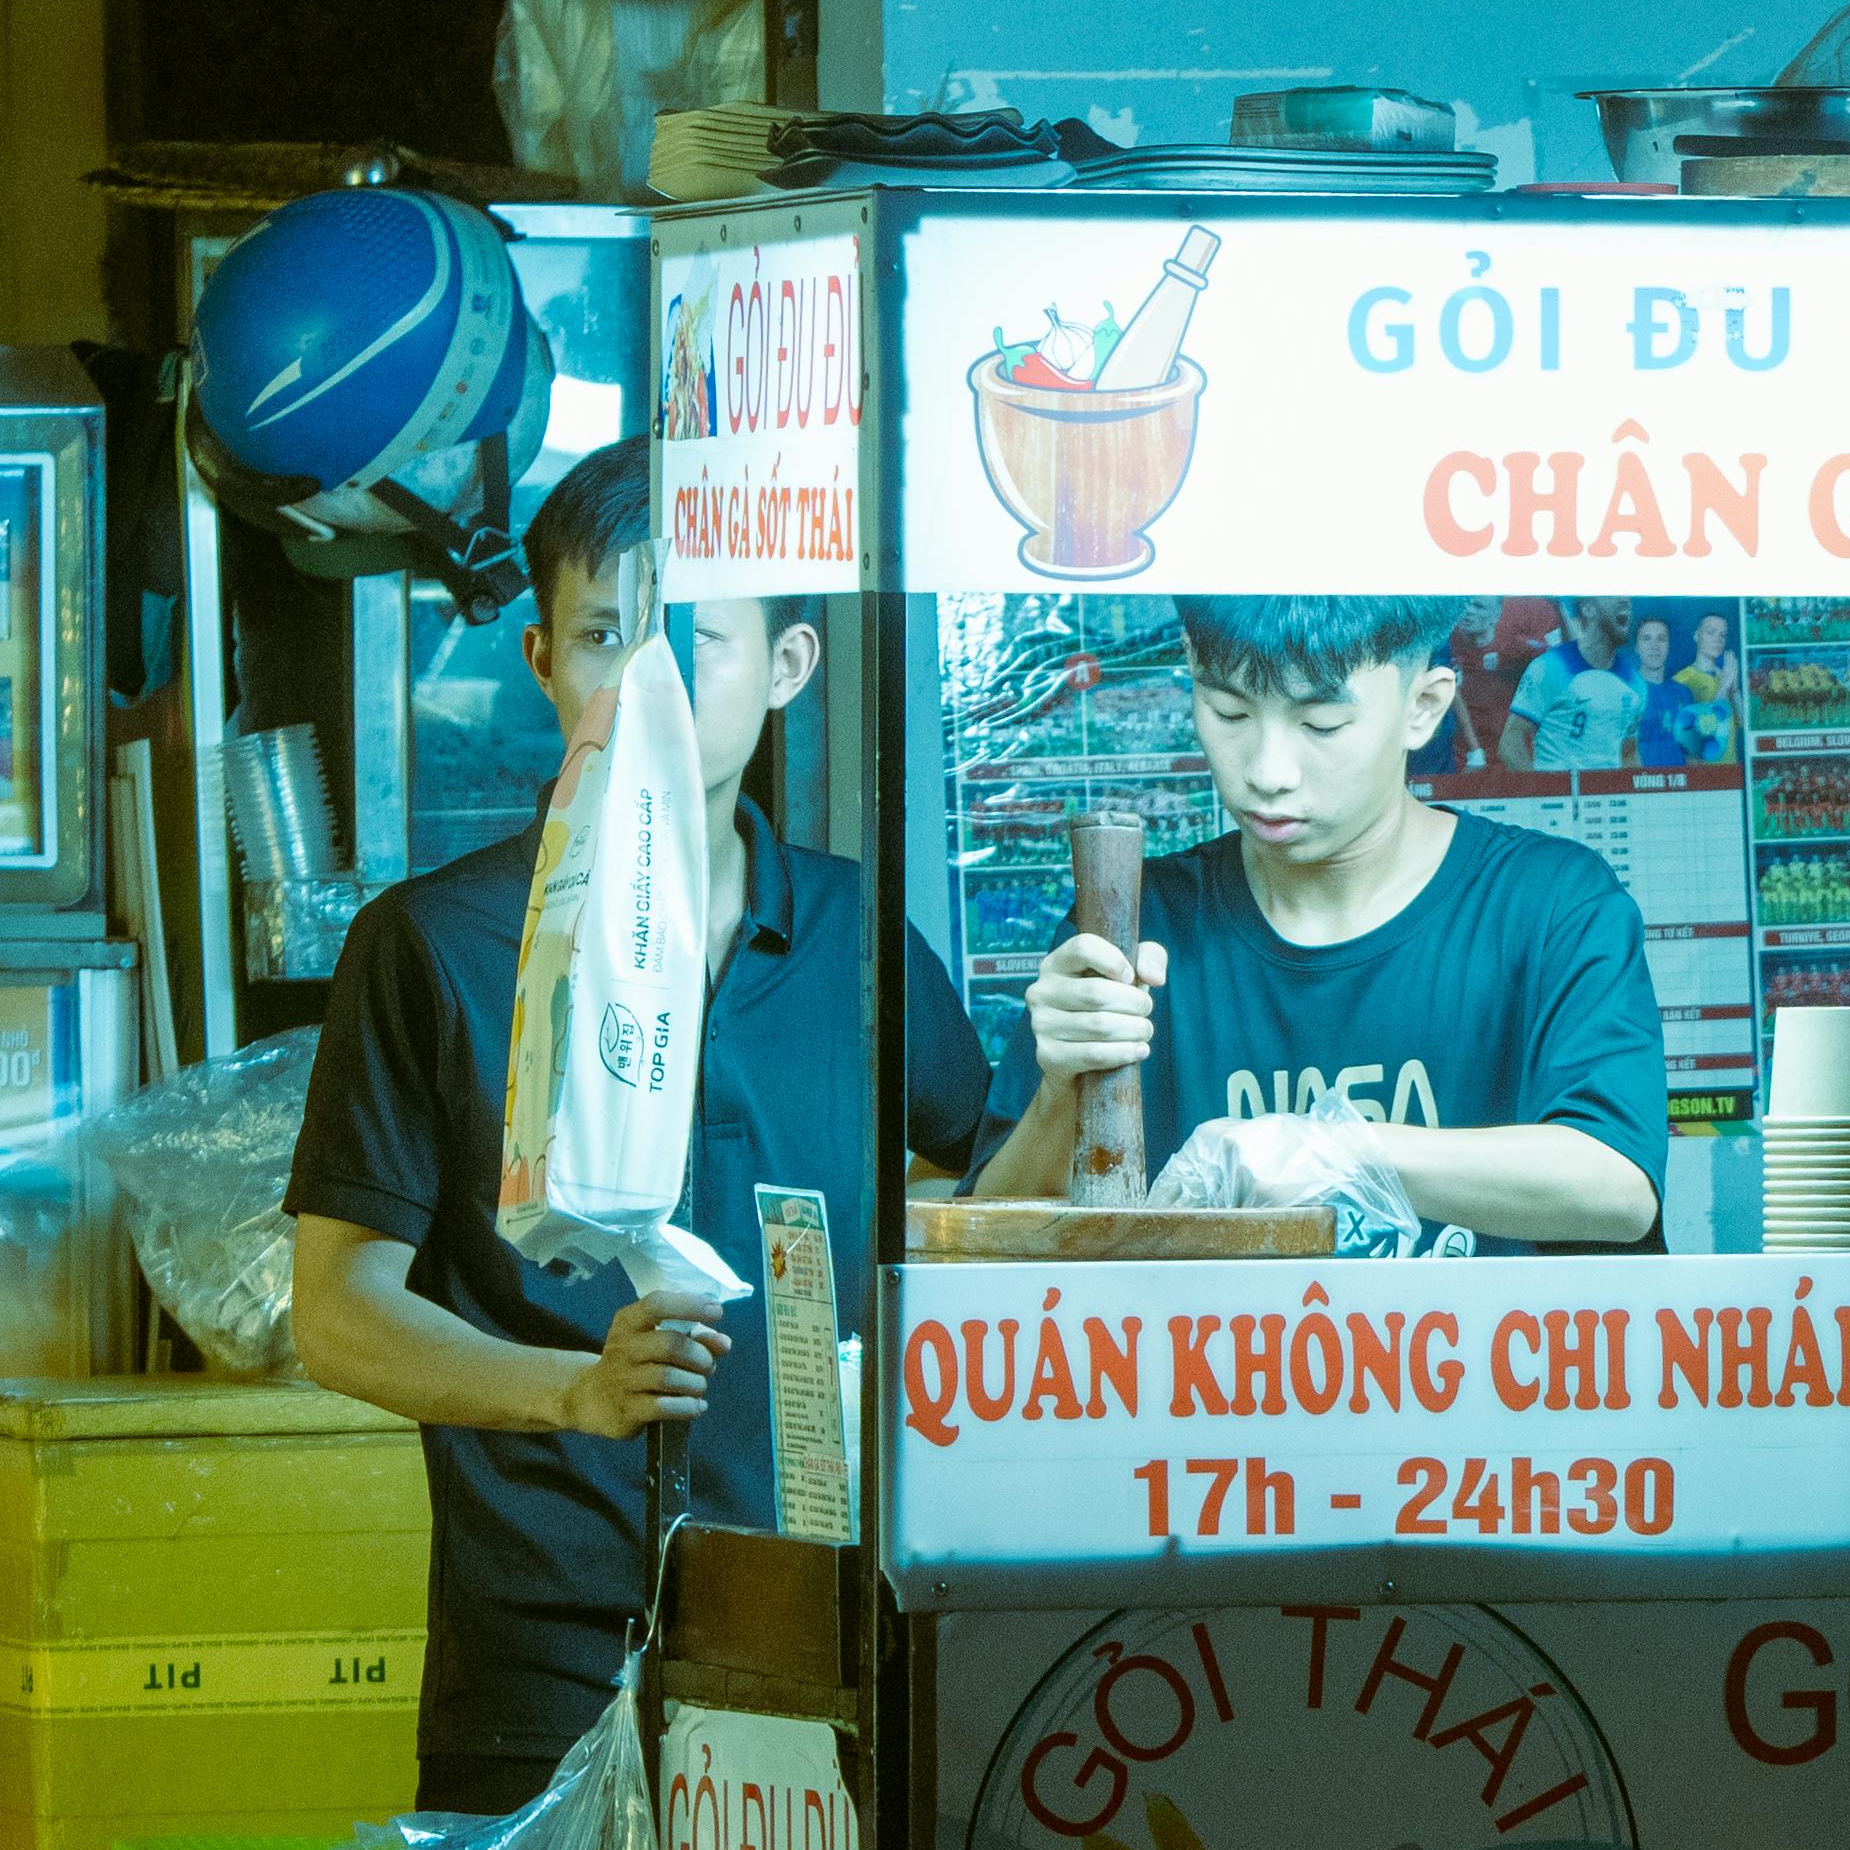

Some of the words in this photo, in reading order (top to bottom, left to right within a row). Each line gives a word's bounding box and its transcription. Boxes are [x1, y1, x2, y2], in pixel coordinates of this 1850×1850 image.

[727, 246, 770, 435] GỎI
[777, 277, 816, 429] ĐU
[1348, 251, 1561, 372] GỎI
[1626, 287, 1792, 371] ĐU
[675, 464, 724, 559] CHÂN
[728, 464, 750, 559] GÀ
[756, 451, 790, 559] SỐT
[797, 465, 853, 561] THÁI
[1422, 418, 1767, 558] CHÂN
[636, 827, 651, 867] CAO
[631, 916, 649, 970] KHĂN
[649, 1052, 665, 1094] TOP
[1227, 1058, 1439, 1129] NASA
[1668, 1095, 1736, 1117] GSON.TV
[904, 1286, 1141, 1447] QUÁN
[1169, 1281, 1465, 1417] KHÔNG
[1491, 1309, 1631, 1411] CHI
[1133, 1458, 1296, 1537] 17h
[1398, 1456, 1675, 1537] 24h30
[144, 1662, 201, 1690] PIT
[329, 1656, 386, 1685] PIT
[1021, 1623, 1234, 1837] GỎI
[1281, 1605, 1588, 1833] THÁI
